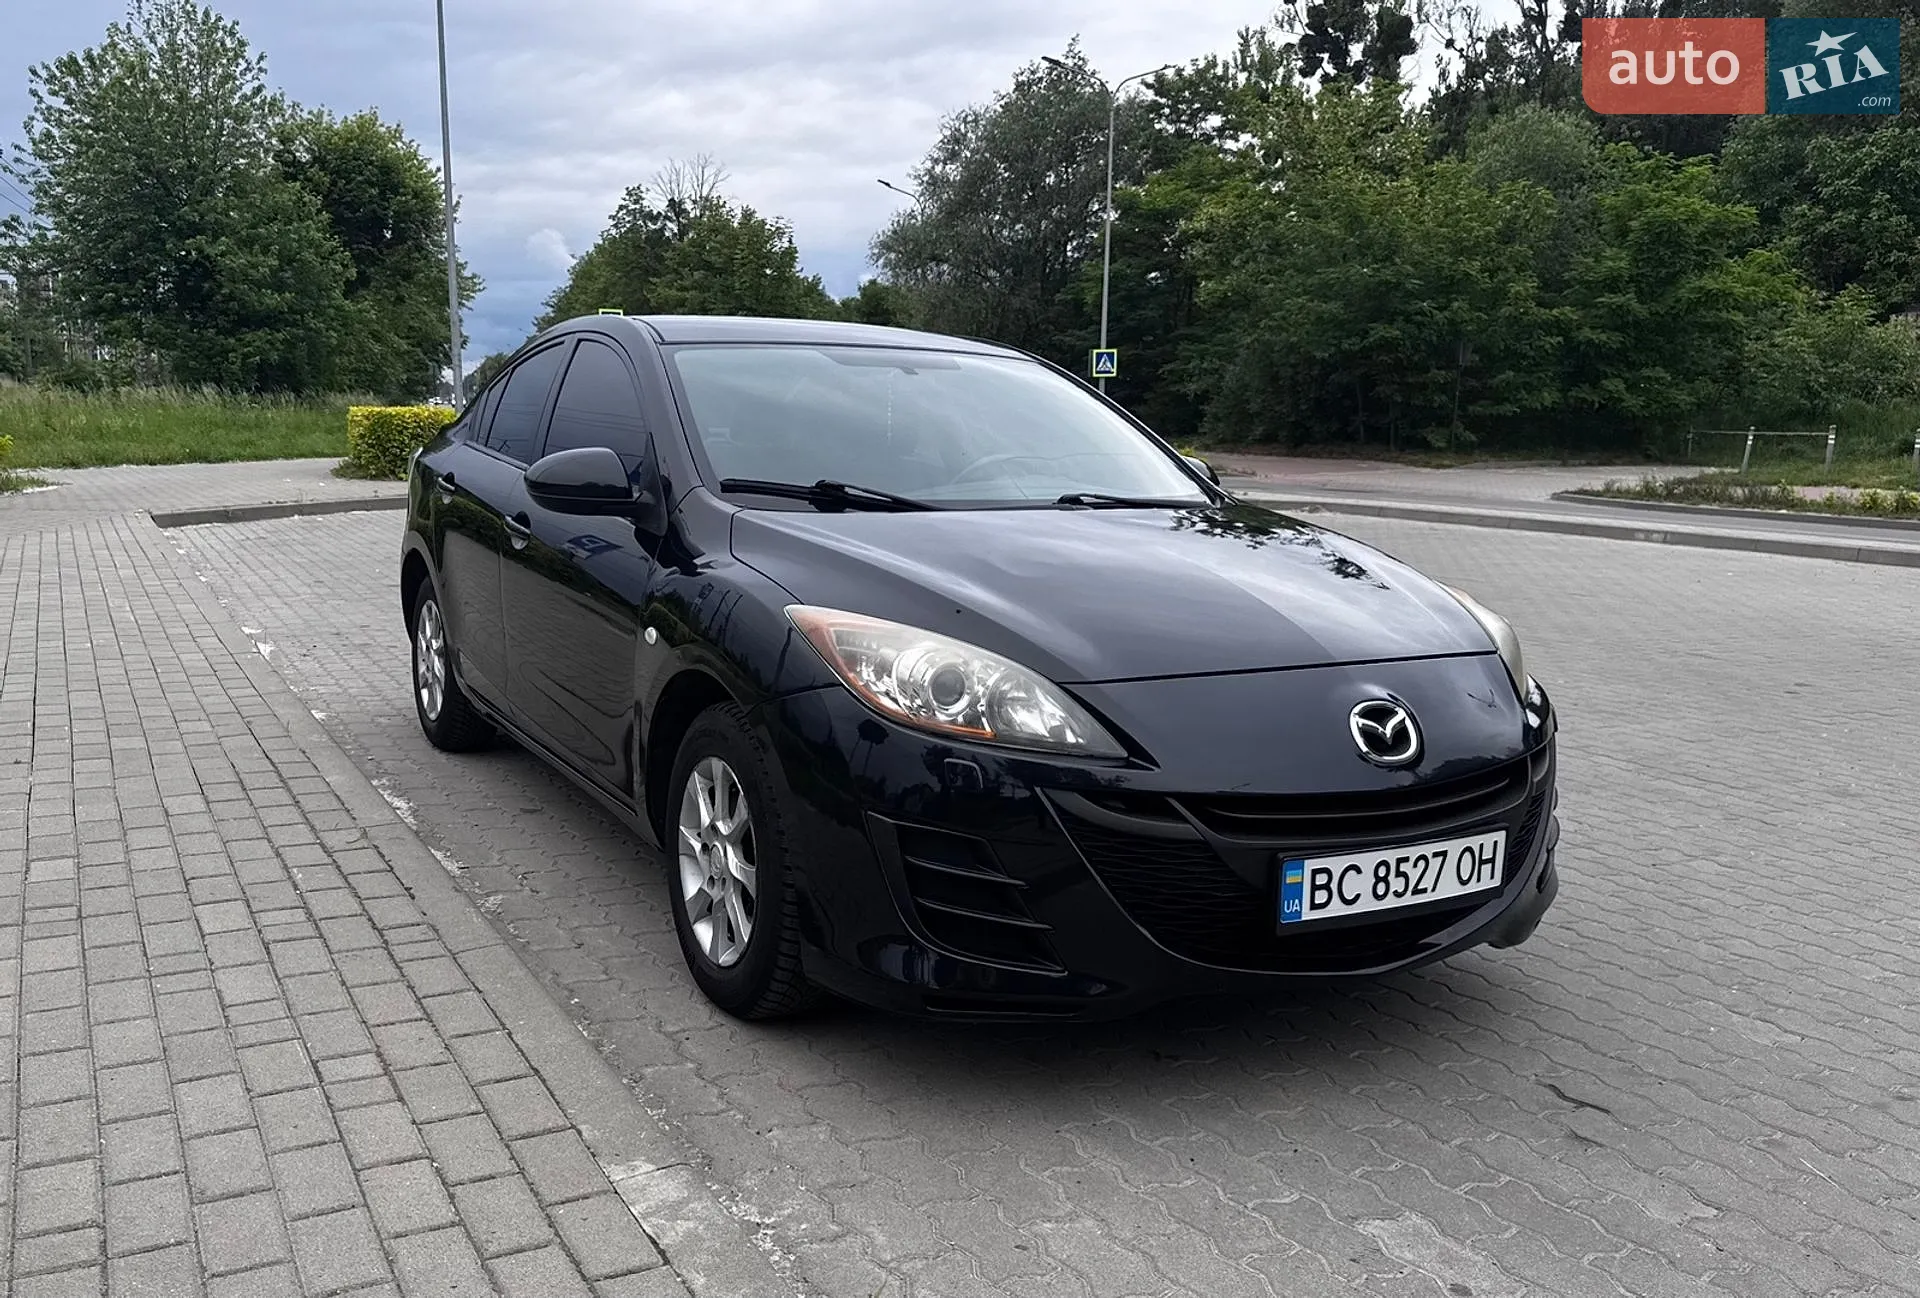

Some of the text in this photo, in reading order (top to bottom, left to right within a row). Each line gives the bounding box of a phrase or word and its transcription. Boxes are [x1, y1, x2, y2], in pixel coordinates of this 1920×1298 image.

[1309, 841, 1499, 911] BC 8527 OH
[1284, 899, 1300, 913] UA
